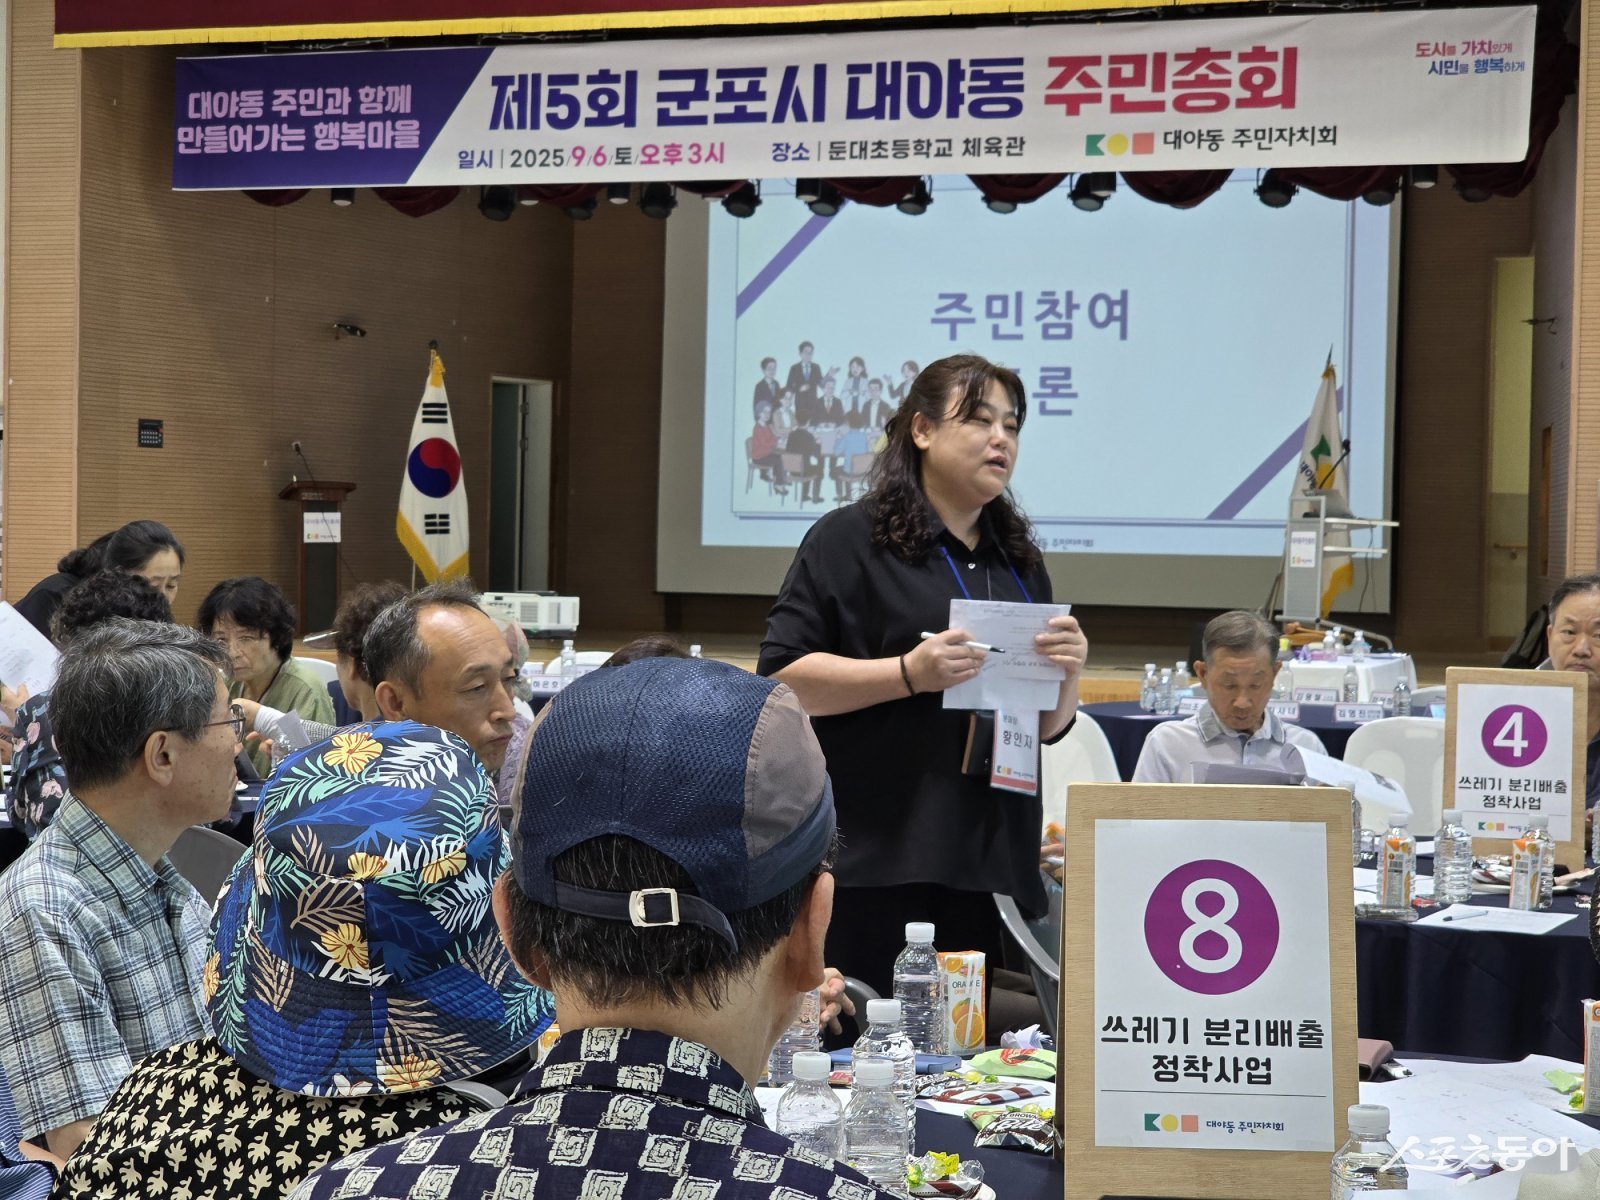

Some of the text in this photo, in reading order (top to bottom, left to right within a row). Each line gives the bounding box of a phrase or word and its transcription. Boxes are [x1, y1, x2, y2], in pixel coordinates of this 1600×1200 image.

[1416, 42, 1456, 57] 도시를
[1428, 58, 1525, 75] 시민을 행복하게
[188, 84, 412, 119] 대야동 주민과 함께
[489, 45, 1298, 131] 제5회 군포시 대야동 주민총회
[177, 119, 421, 154] 만들어가는 행복마을
[771, 136, 1026, 162] 장소 둔대초등학교 체육관
[1163, 125, 1338, 152] 대야동 주민자치회
[458, 150, 493, 169] 일시
[930, 289, 1129, 342] 주민참여
[1003, 730, 1033, 749] 황인자
[1493, 711, 1529, 757] 4
[1458, 776, 1568, 794] 쓰레기 분리배출
[1482, 795, 1541, 810] 정착사업
[1179, 878, 1243, 974] 8
[1100, 1015, 1325, 1049] 쓰레기 분리배출
[1152, 1055, 1272, 1085] 정착사업
[1206, 1120, 1285, 1134] 대야동 주민자치회
